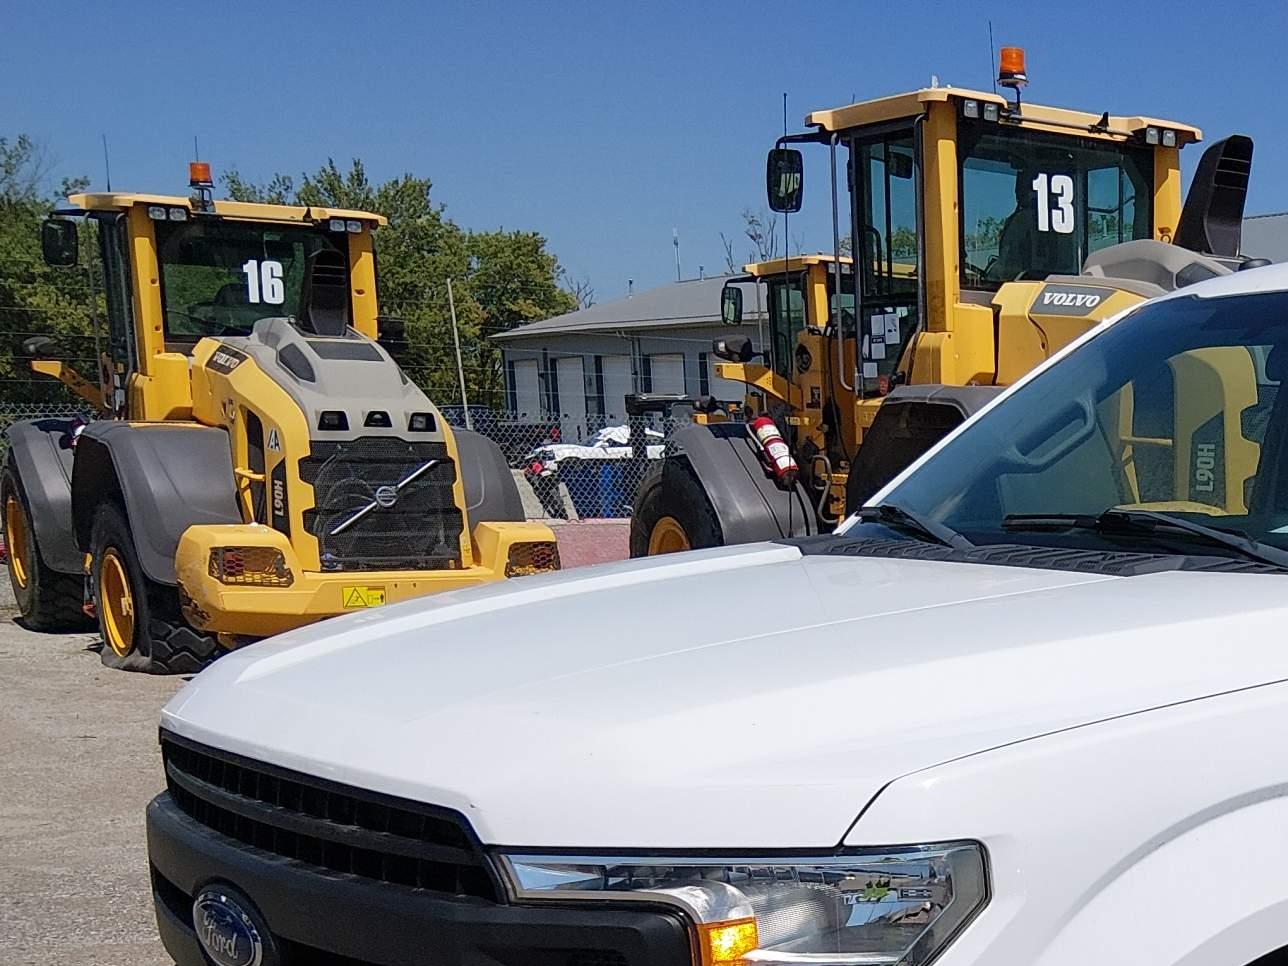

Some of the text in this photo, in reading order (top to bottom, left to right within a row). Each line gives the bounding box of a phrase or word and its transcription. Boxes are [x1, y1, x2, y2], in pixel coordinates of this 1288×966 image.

[1032, 173, 1075, 234] 13
[243, 259, 285, 304] 16
[1042, 292, 1100, 308] VOLVO
[213, 351, 241, 369] VOLVO
[1195, 443, 1216, 492] L90H
[273, 480, 285, 516] L90H
[201, 909, 239, 959] Ford
